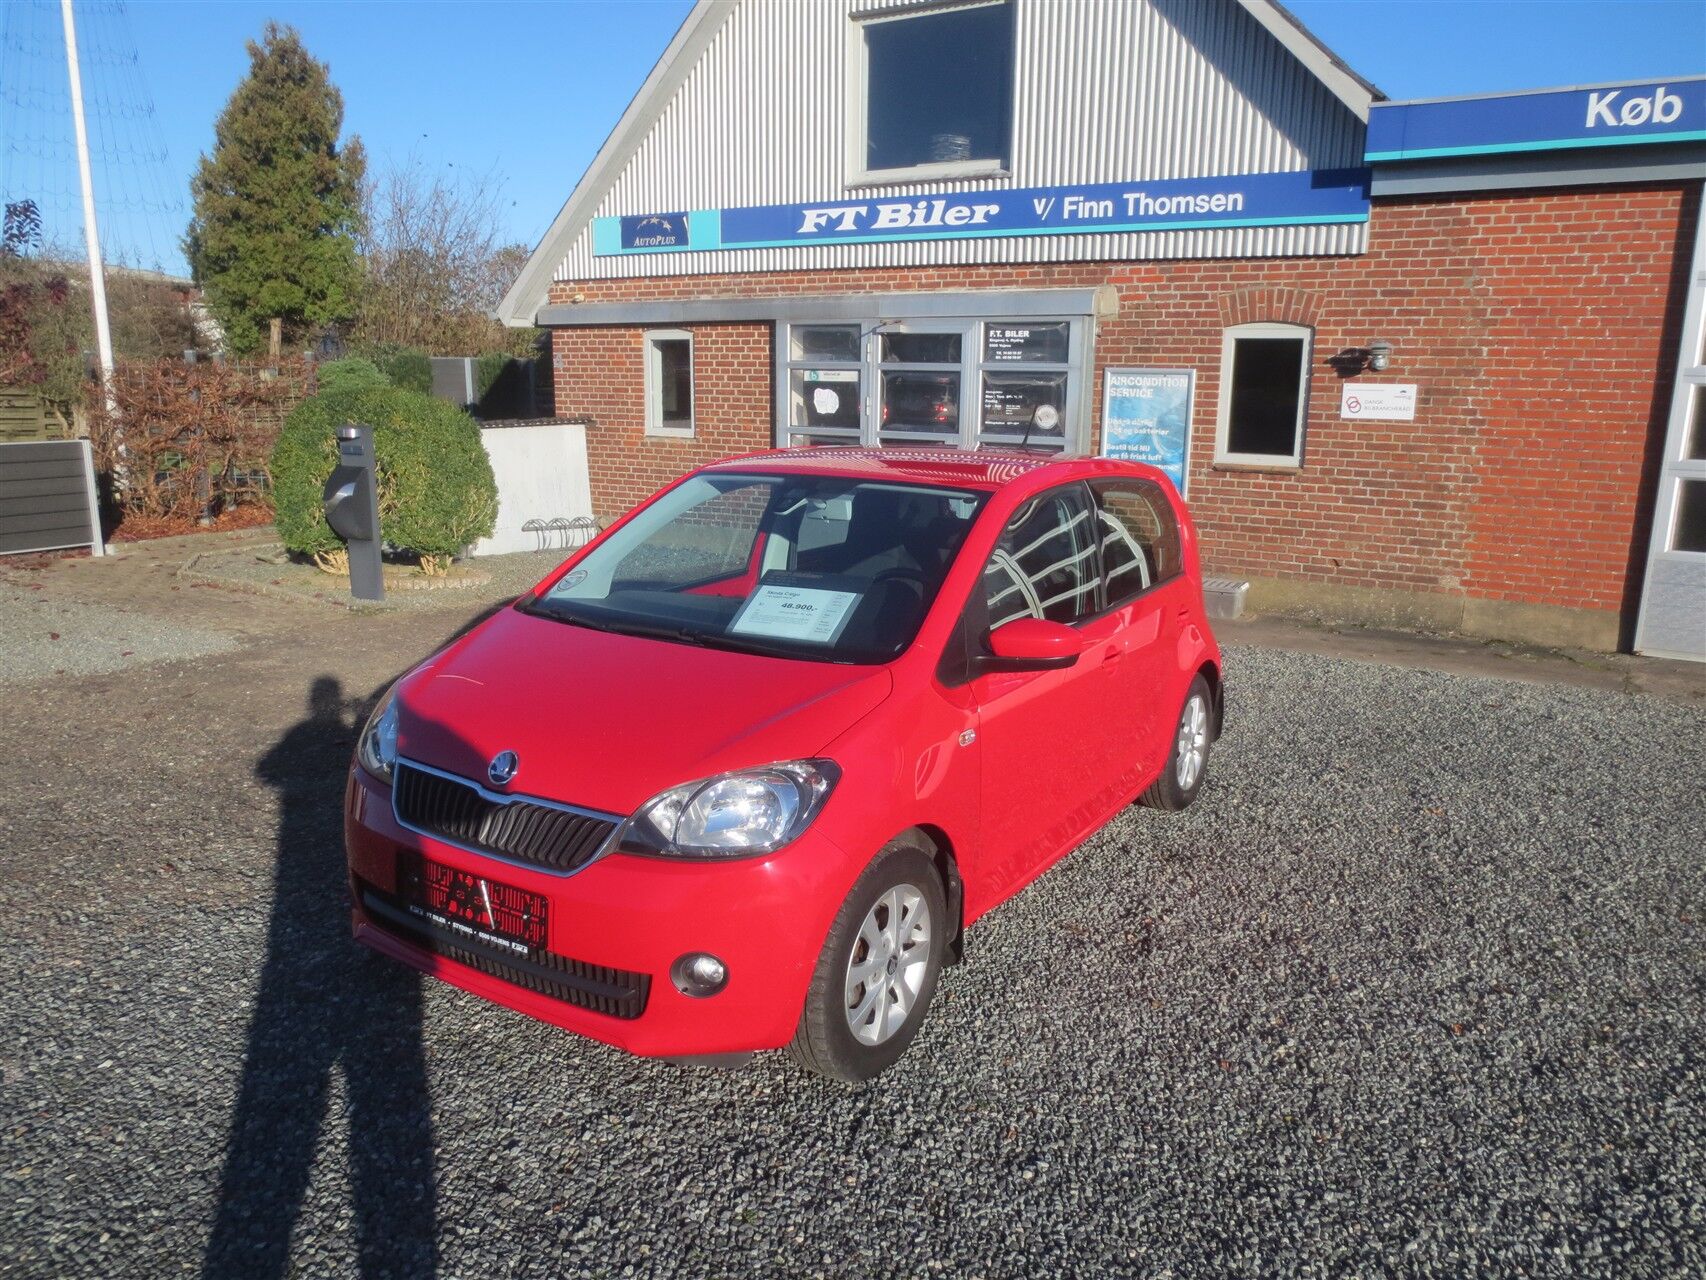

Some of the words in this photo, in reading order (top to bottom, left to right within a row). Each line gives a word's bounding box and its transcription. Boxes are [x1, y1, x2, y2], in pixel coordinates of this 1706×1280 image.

[1585, 87, 1683, 128] Køb
[796, 205, 869, 233] FT
[870, 199, 999, 229] Biler
[1063, 195, 1113, 219] Finn
[1123, 191, 1243, 216] Thomsen
[1109, 388, 1153, 398] SERVICE
[1110, 376, 1188, 388] AIRCONDITION
